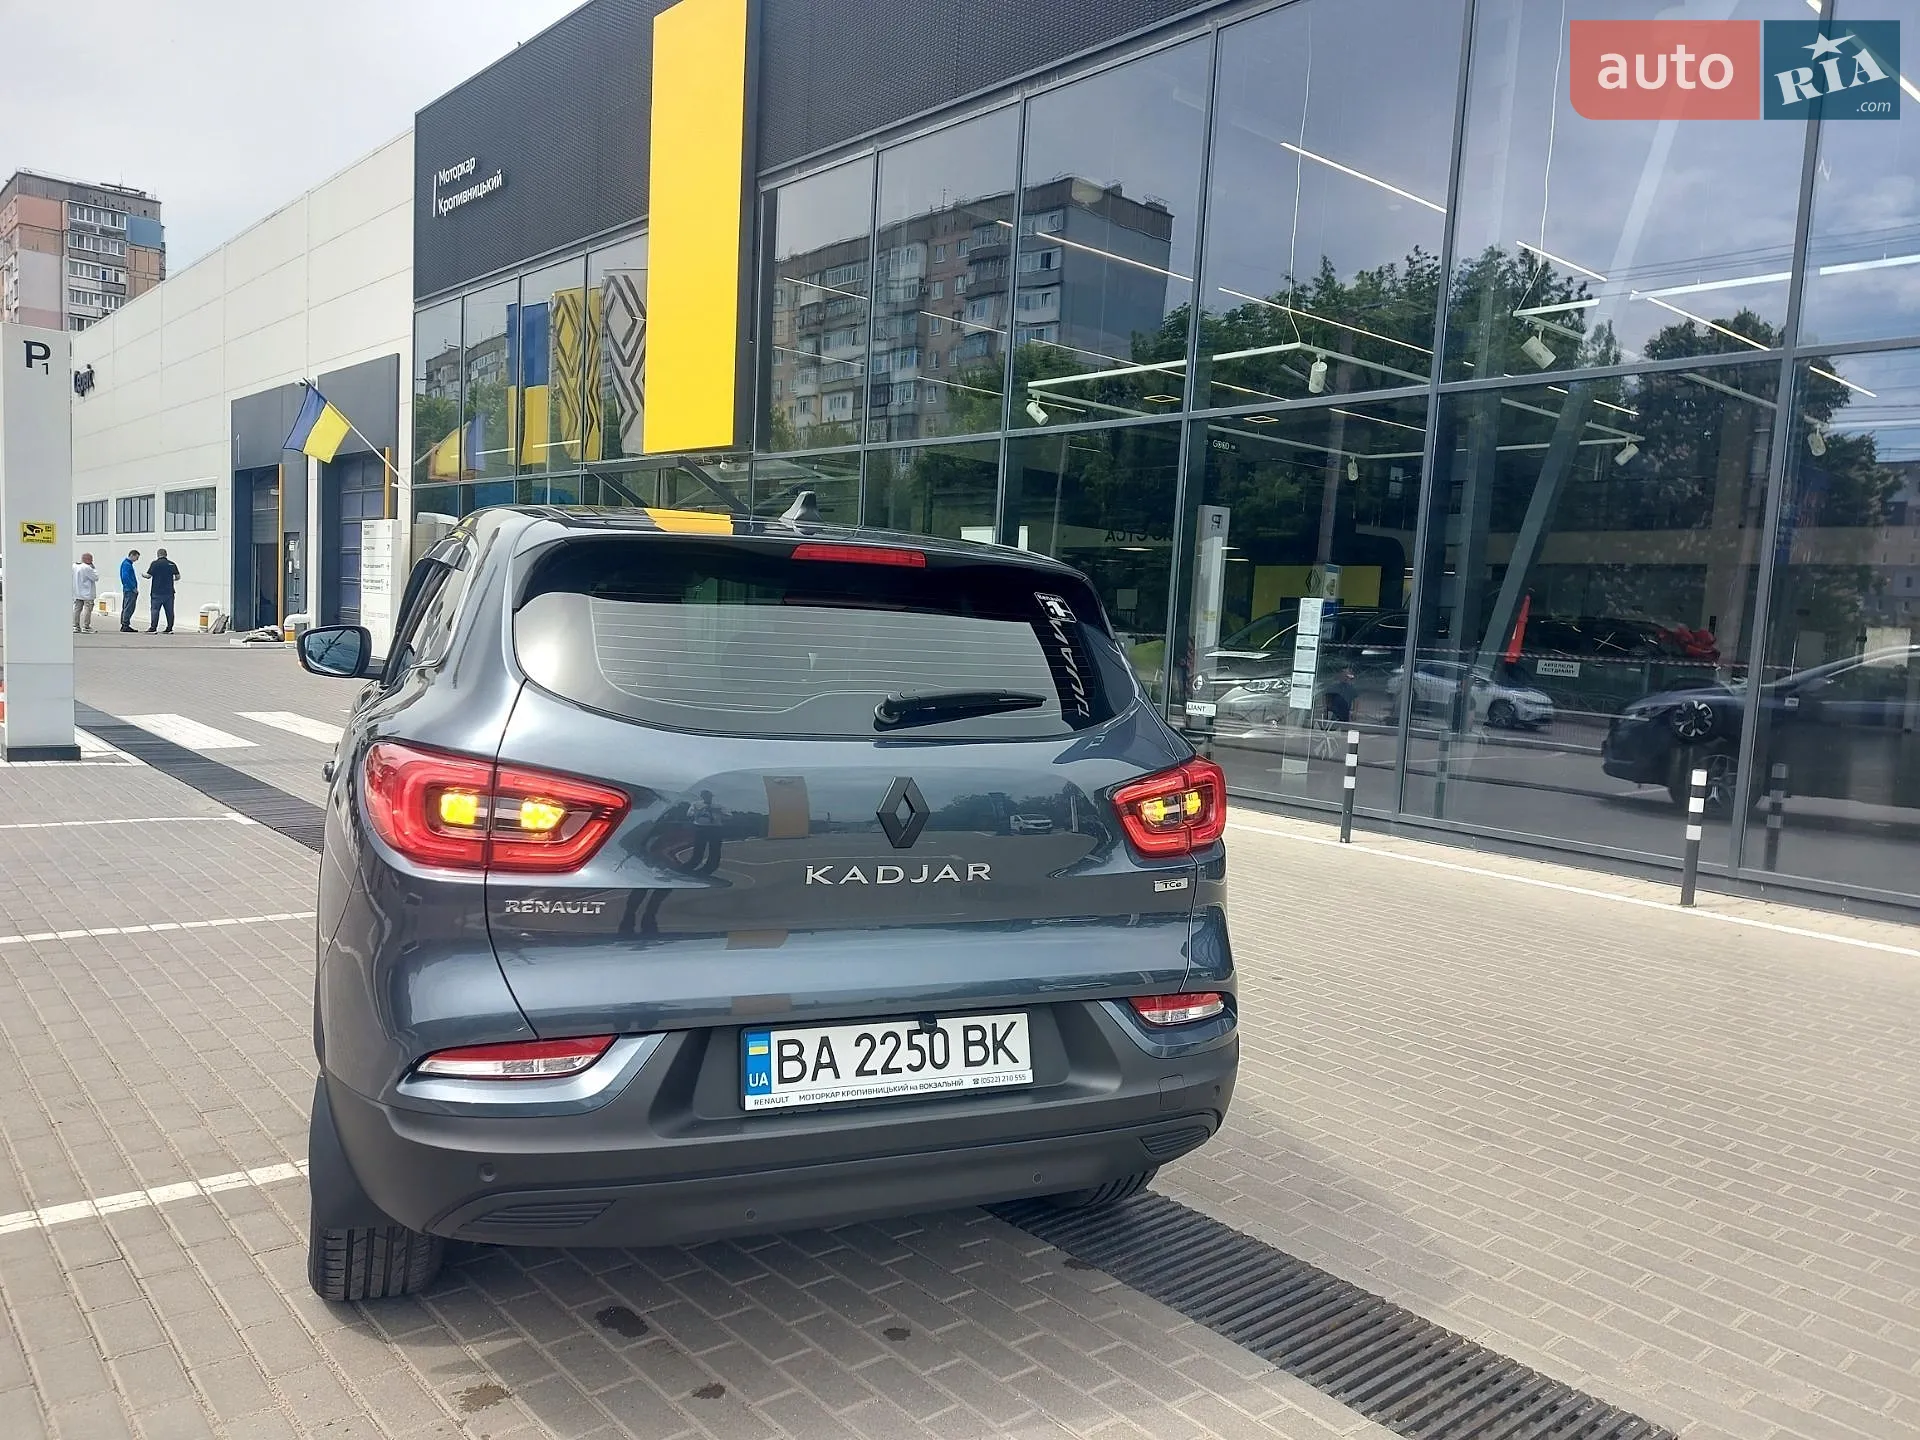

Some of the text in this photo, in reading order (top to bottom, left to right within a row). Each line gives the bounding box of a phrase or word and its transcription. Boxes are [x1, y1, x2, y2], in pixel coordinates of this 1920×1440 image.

[438, 157, 476, 186] Моторкар
[438, 169, 503, 216] Кропивницький
[805, 862, 992, 885] KADJAR
[1163, 881, 1182, 889] TCe
[504, 899, 606, 914] RENAULT
[777, 1022, 1019, 1084] BA 2250 BK
[749, 1072, 769, 1087] UA
[754, 1096, 789, 1106] RENAULT
[798, 1091, 841, 1101] МОТОРКАР
[841, 1082, 908, 1098] КРОПИВНИЦЬКИЙ
[919, 1079, 964, 1090] ВОКЗАЛЬНІЙ
